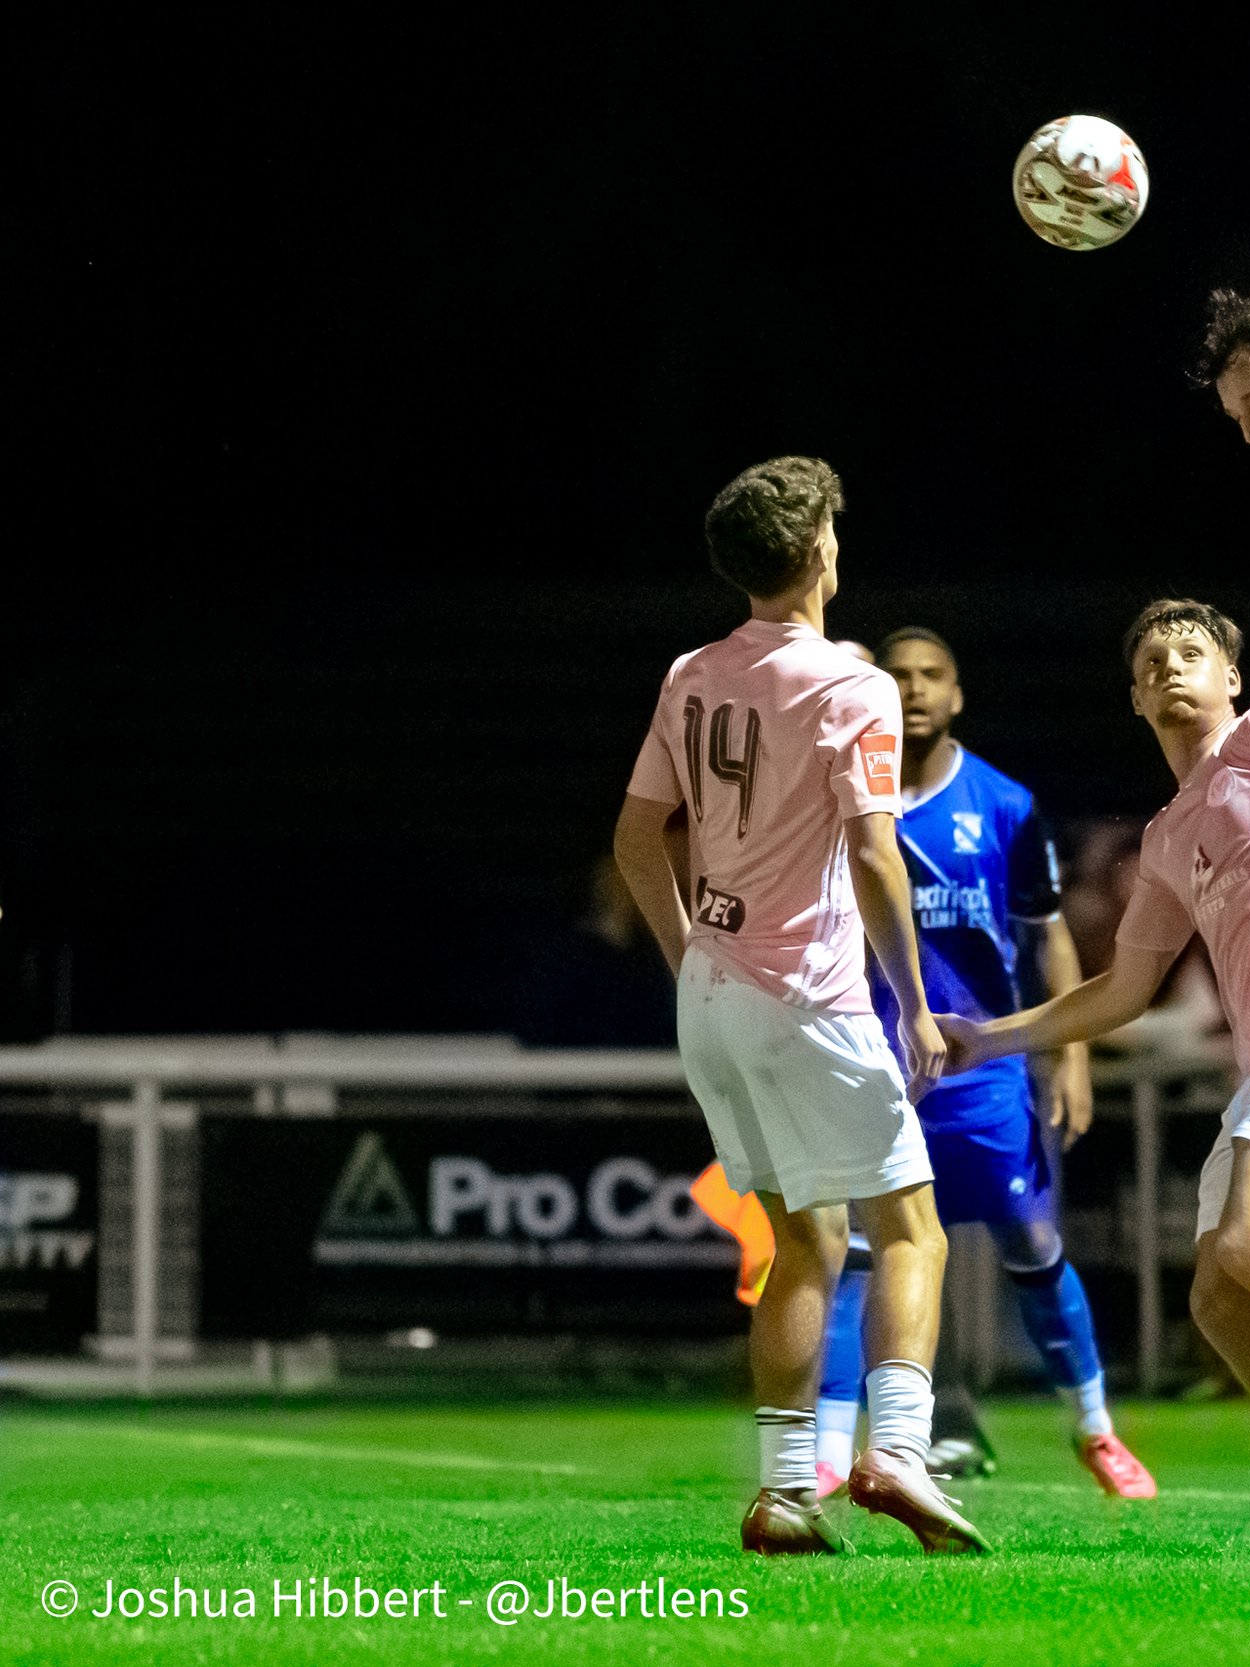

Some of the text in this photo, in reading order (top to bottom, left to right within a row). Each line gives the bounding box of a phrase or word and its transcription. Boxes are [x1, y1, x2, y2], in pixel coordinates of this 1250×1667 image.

[683, 695, 762, 843] 14
[429, 1157, 728, 1238] Pro Co
